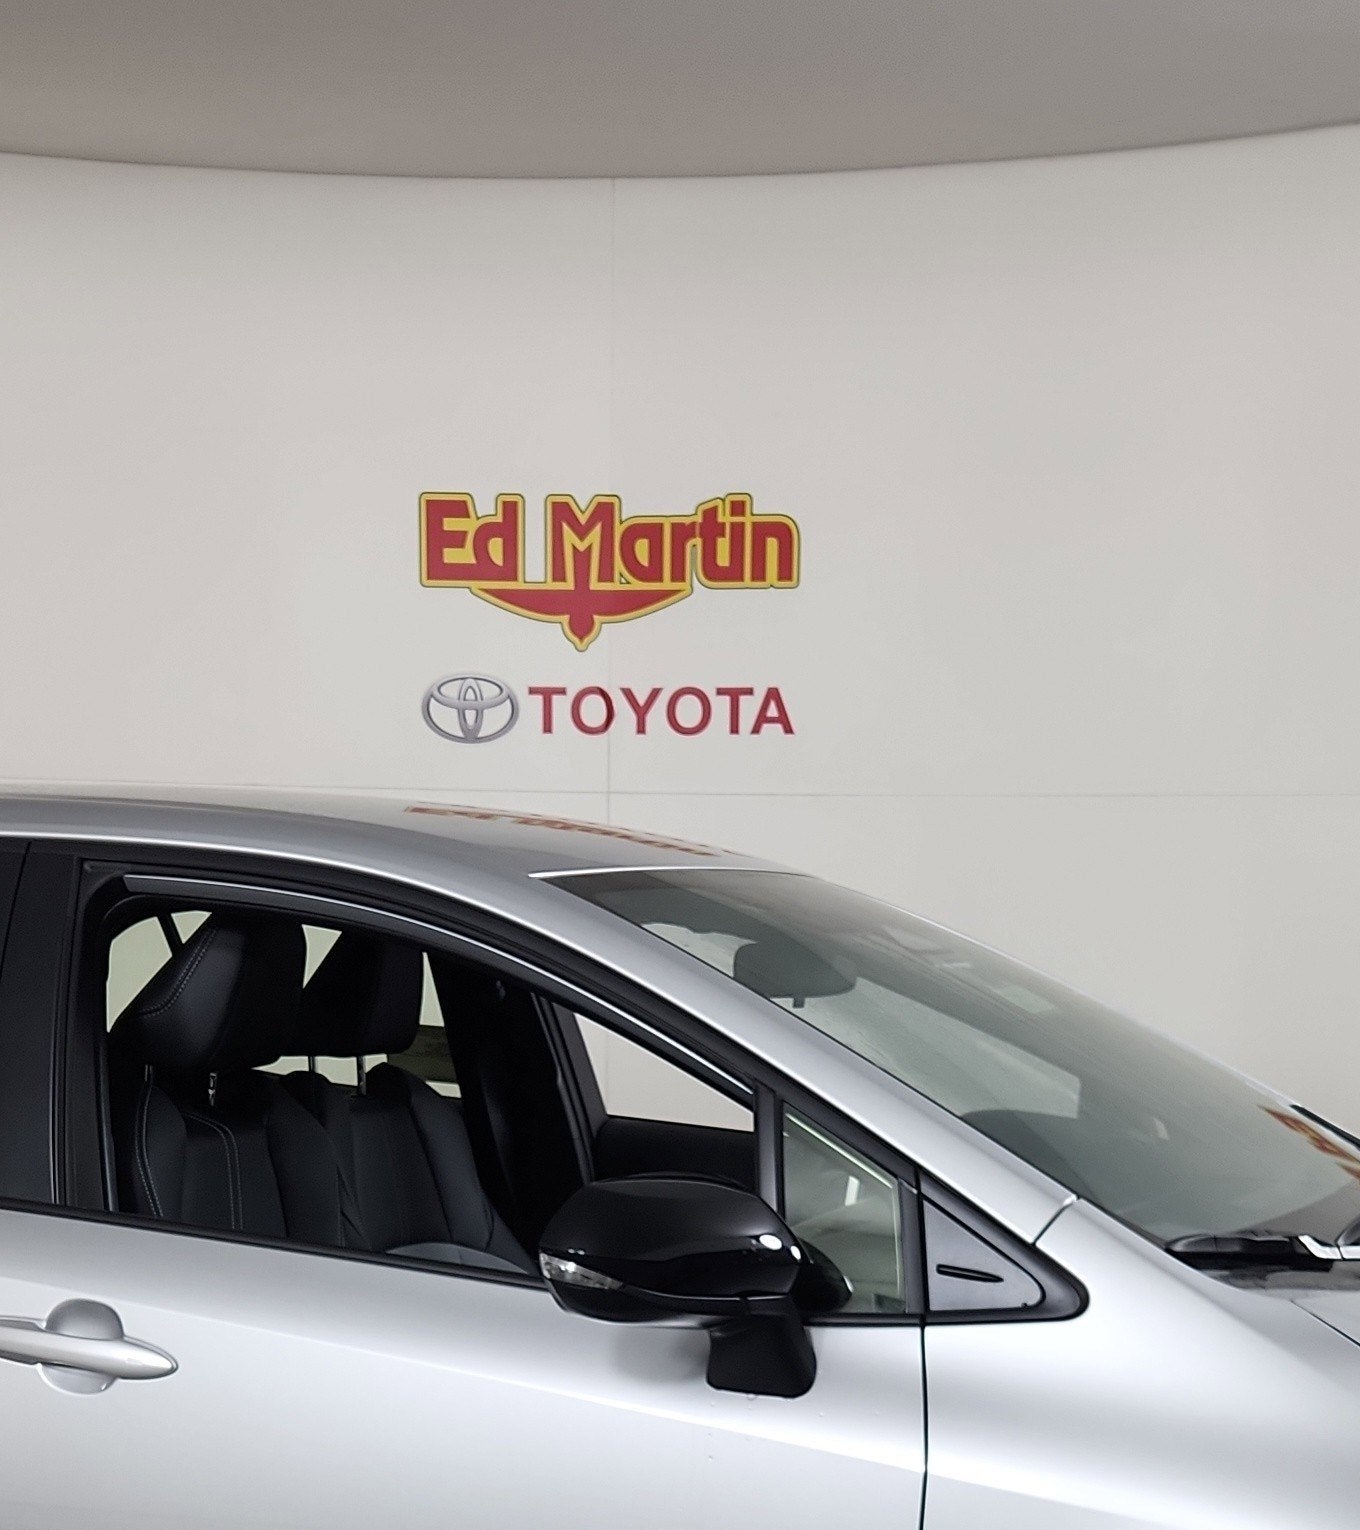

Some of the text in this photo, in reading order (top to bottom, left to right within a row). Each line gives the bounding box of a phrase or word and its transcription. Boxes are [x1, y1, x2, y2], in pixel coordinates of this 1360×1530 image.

[423, 497, 797, 585] Ed Martin
[527, 685, 796, 737] TOYOTA
